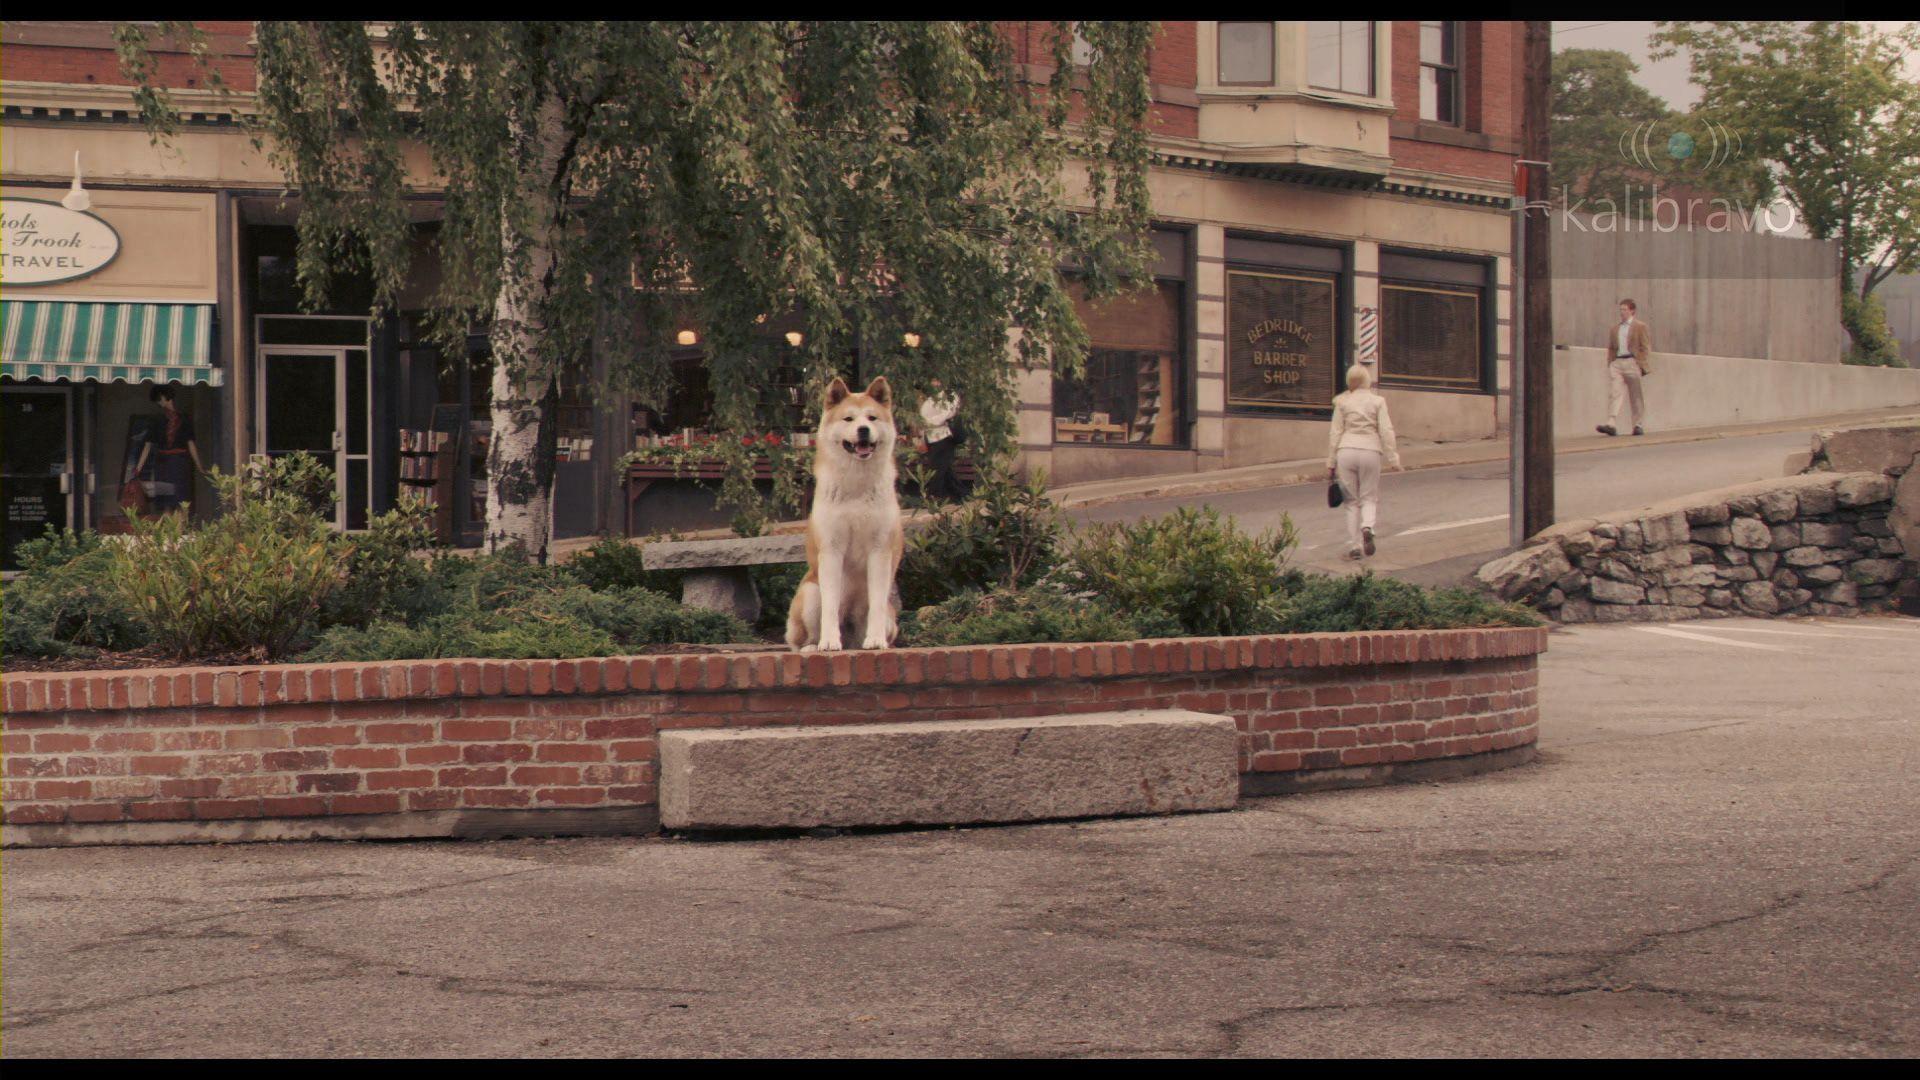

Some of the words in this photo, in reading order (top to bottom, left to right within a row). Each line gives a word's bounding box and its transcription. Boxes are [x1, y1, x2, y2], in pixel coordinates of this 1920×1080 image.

[12, 231, 82, 248] Trook
[0, 253, 84, 268] TRAVEL
[1247, 319, 1313, 343] BEDRIDGE
[1254, 351, 1306, 367] BARBER
[1263, 370, 1300, 384] SHOP
